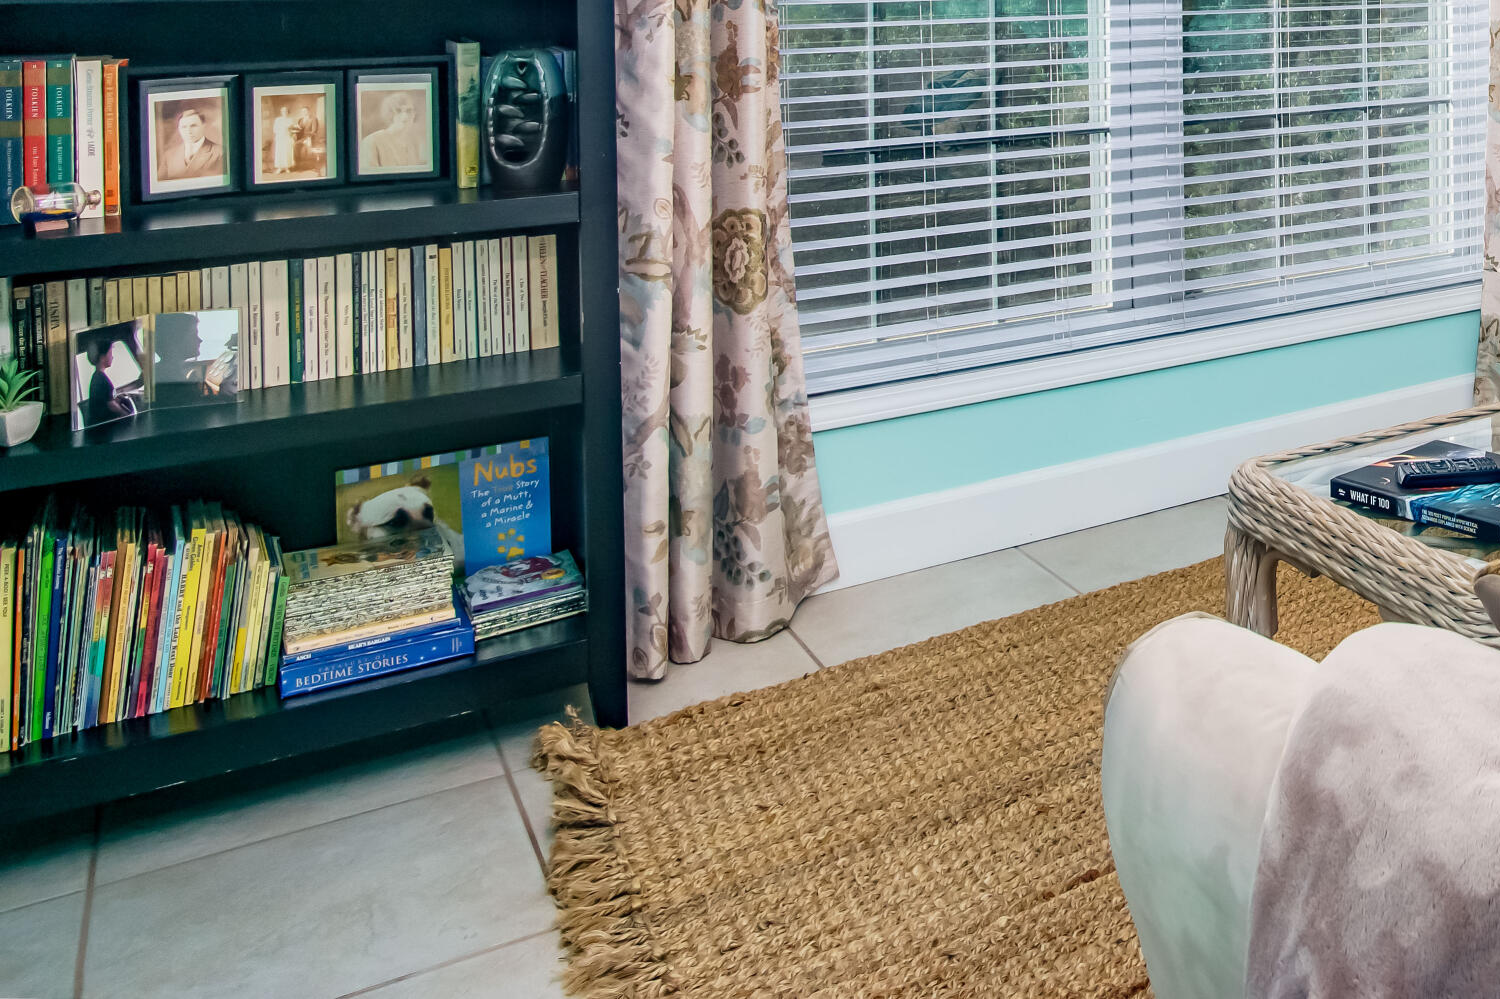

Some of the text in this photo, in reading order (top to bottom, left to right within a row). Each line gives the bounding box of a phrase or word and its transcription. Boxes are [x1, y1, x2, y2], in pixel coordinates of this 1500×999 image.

[474, 454, 538, 486] Nubs
[471, 480, 540, 499] The Story
[482, 497, 493, 508] of
[504, 490, 531, 502] Mutt,
[490, 504, 524, 516] Marine
[525, 500, 534, 510] &
[1350, 490, 1390, 510] WHAT IF 100
[494, 511, 530, 526] Miracle
[168, 574, 188, 678] HARRY and the Lady Next Door
[296, 654, 408, 688] BEDTIME STORIES
